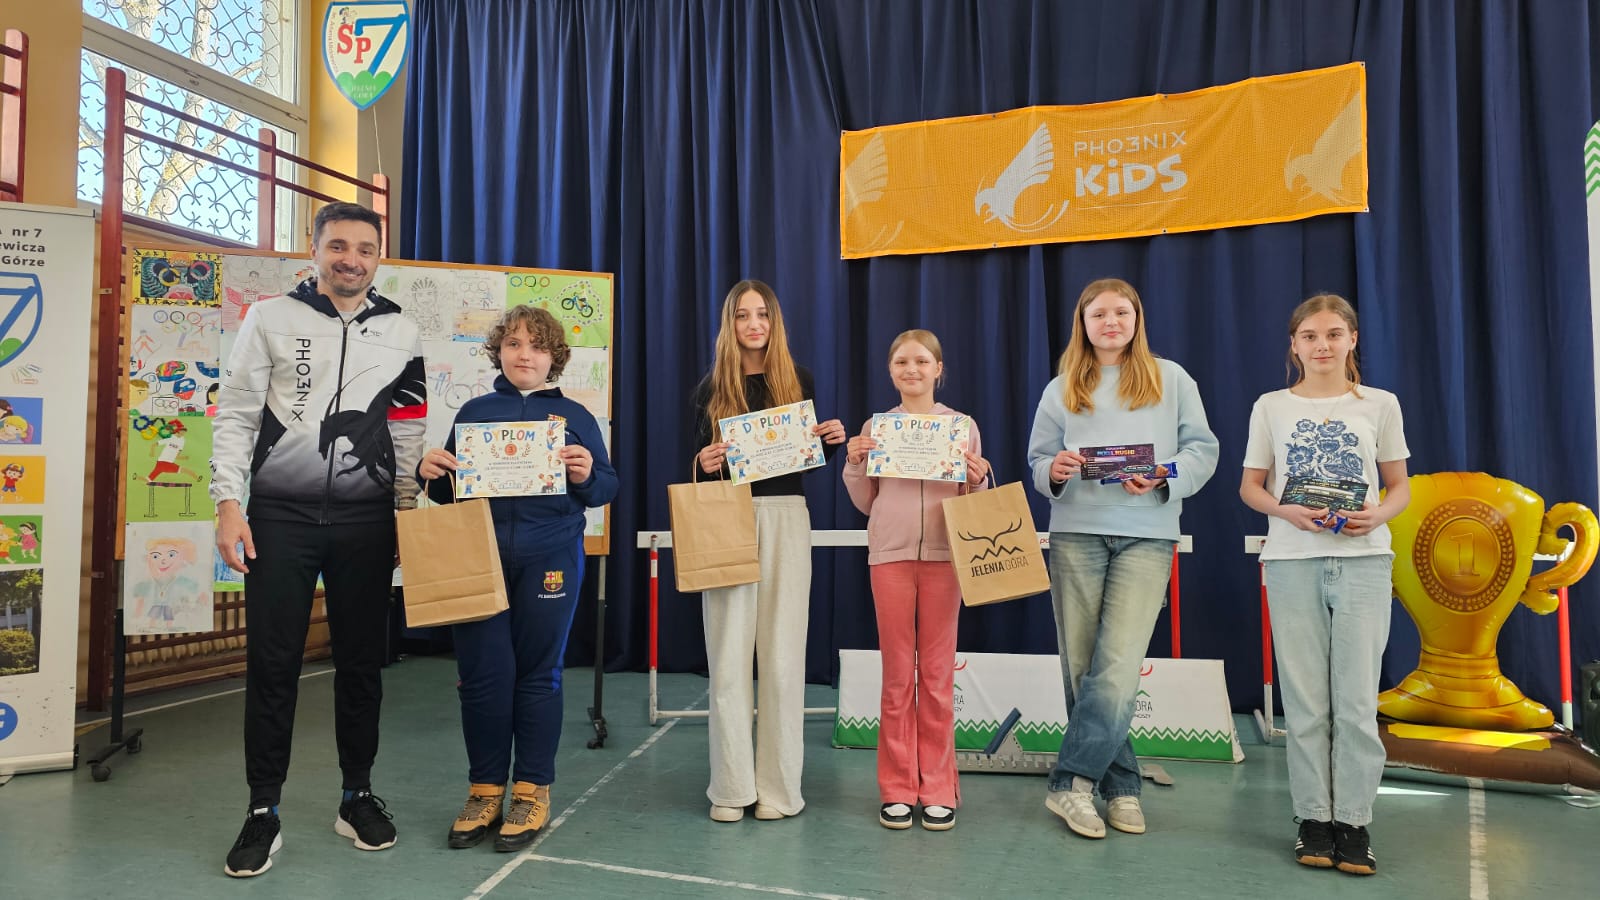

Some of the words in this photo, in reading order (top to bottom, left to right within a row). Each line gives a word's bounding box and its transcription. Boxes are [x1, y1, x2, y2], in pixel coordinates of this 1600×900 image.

[12, 228, 29, 238] nr
[34, 228, 42, 238] 7
[1, 255, 45, 267] Górze
[742, 414, 791, 434] DYPLOM
[894, 419, 941, 431] DYPLOM
[483, 429, 535, 444] DYPLOM
[970, 561, 1005, 578] JELENIA
[953, 694, 965, 704] RA
